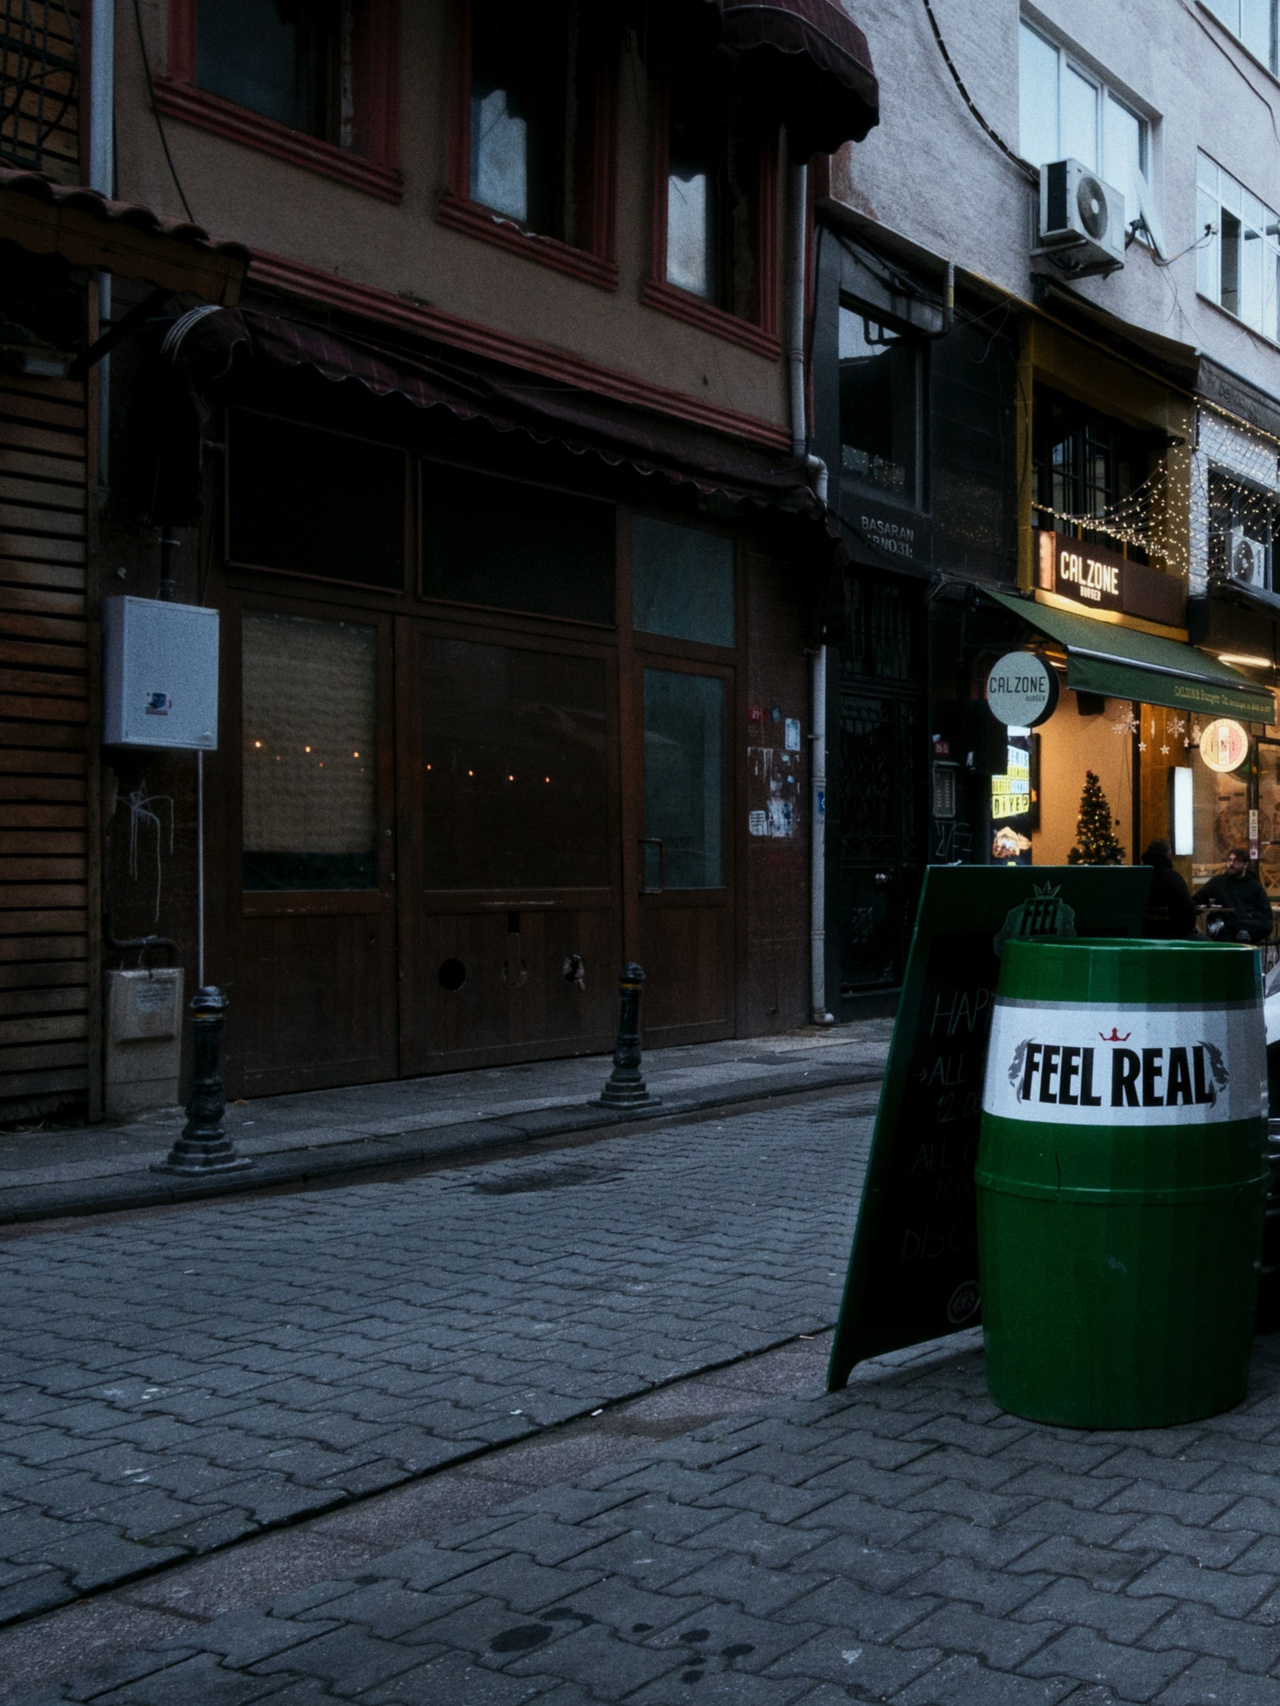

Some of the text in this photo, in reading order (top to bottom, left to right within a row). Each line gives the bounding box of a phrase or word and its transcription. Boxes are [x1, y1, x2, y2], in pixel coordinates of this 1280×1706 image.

[1060, 551, 1119, 596] CALZONE
[989, 676, 1047, 693] CALZONE
[1021, 899, 1060, 936] FEEL
[1021, 1043, 1213, 1107] FEEL REAL
